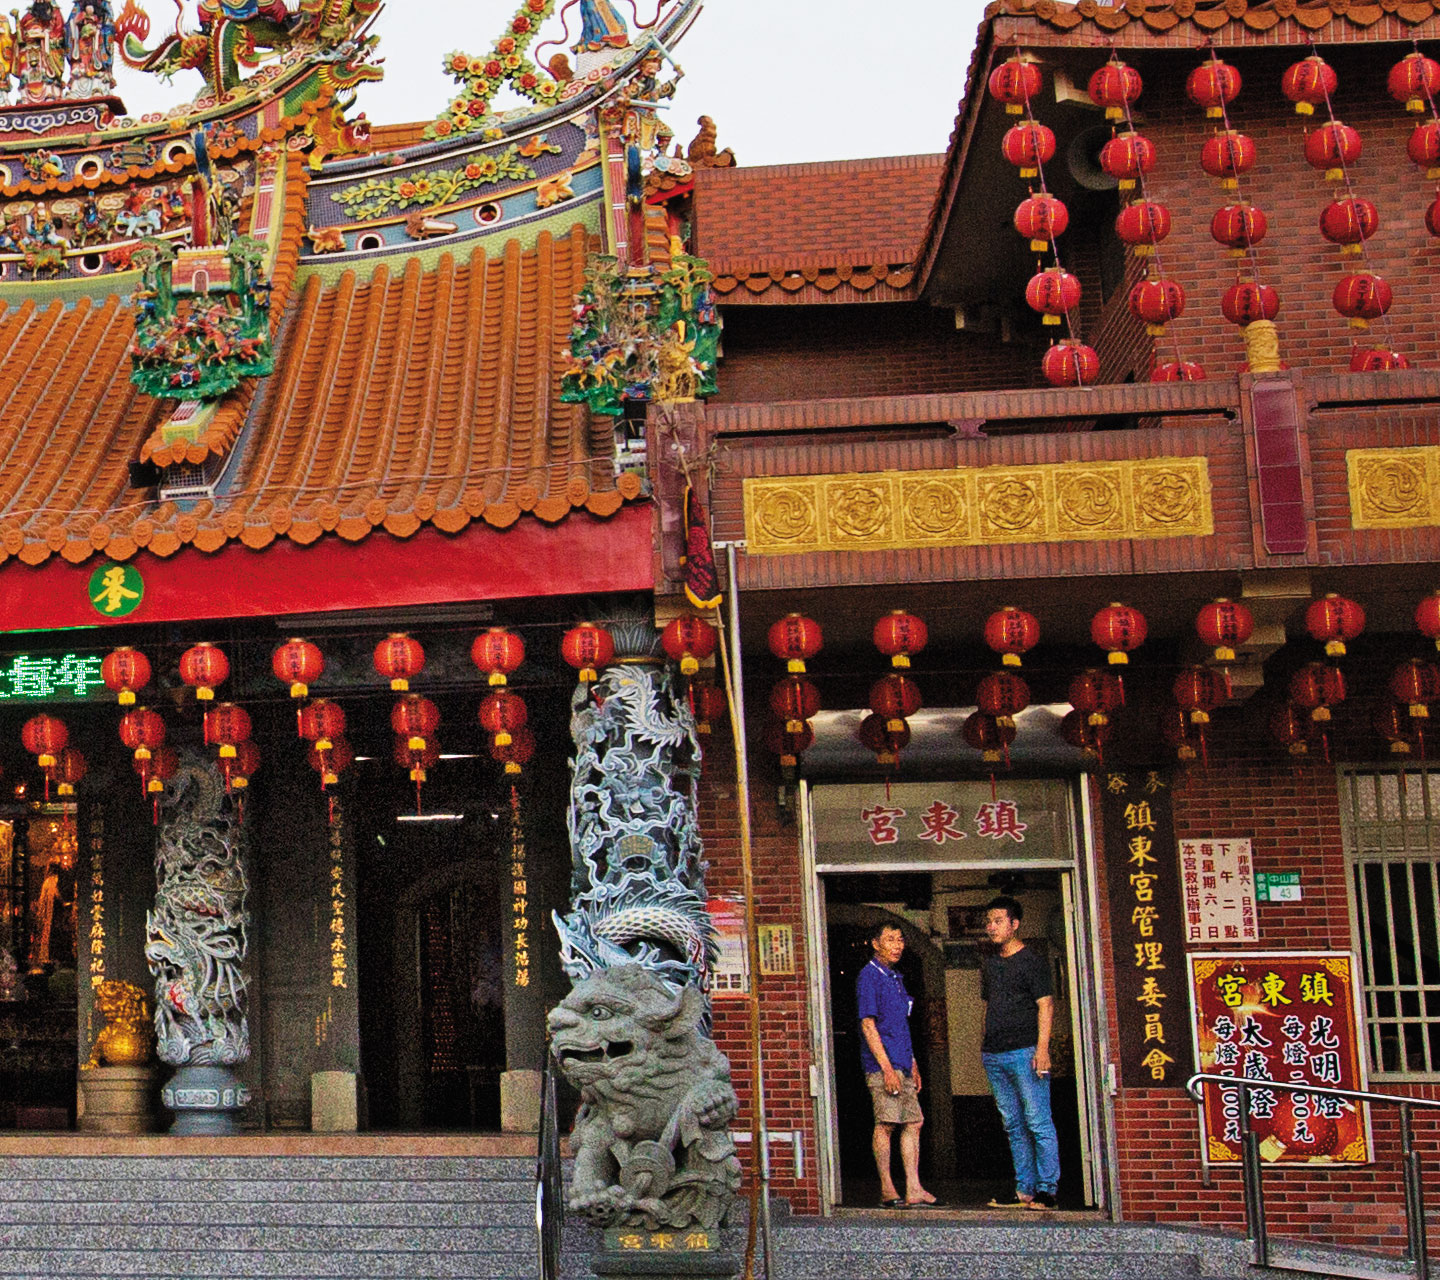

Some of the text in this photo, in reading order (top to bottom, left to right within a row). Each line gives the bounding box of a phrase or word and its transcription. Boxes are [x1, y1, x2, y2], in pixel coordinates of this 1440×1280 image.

[861, 800, 1028, 846] 鎮東宮
[1218, 843, 1238, 939] 下午二點
[1124, 801, 1175, 1081] 鎮東宮管理委員會
[1217, 971, 1335, 1007] 鎮東宮
